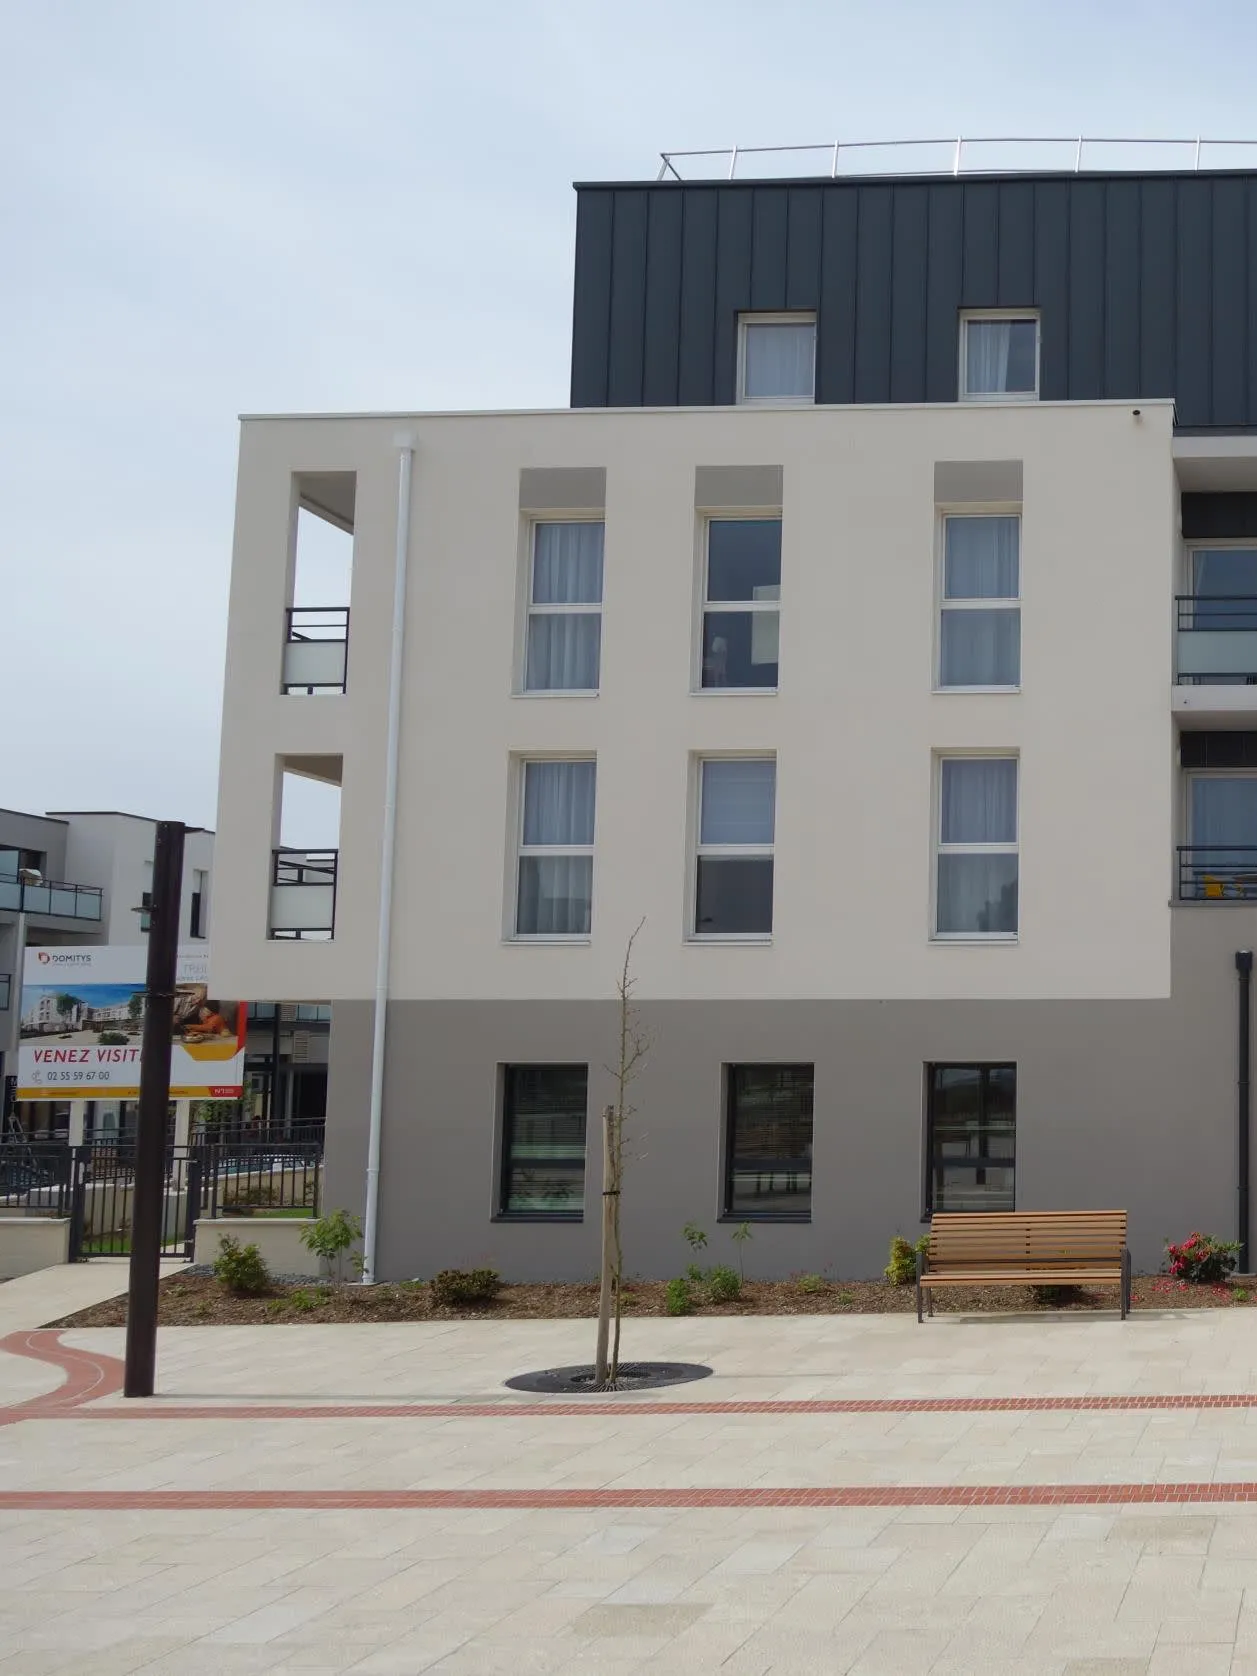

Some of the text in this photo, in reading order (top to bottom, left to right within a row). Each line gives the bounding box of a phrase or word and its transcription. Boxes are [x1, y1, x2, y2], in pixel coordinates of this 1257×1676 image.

[52, 954, 92, 963] DOMITYS
[34, 1049, 142, 1063] VENEZ VISIT
[47, 1072, 110, 1081] 02 55 59 67 00
